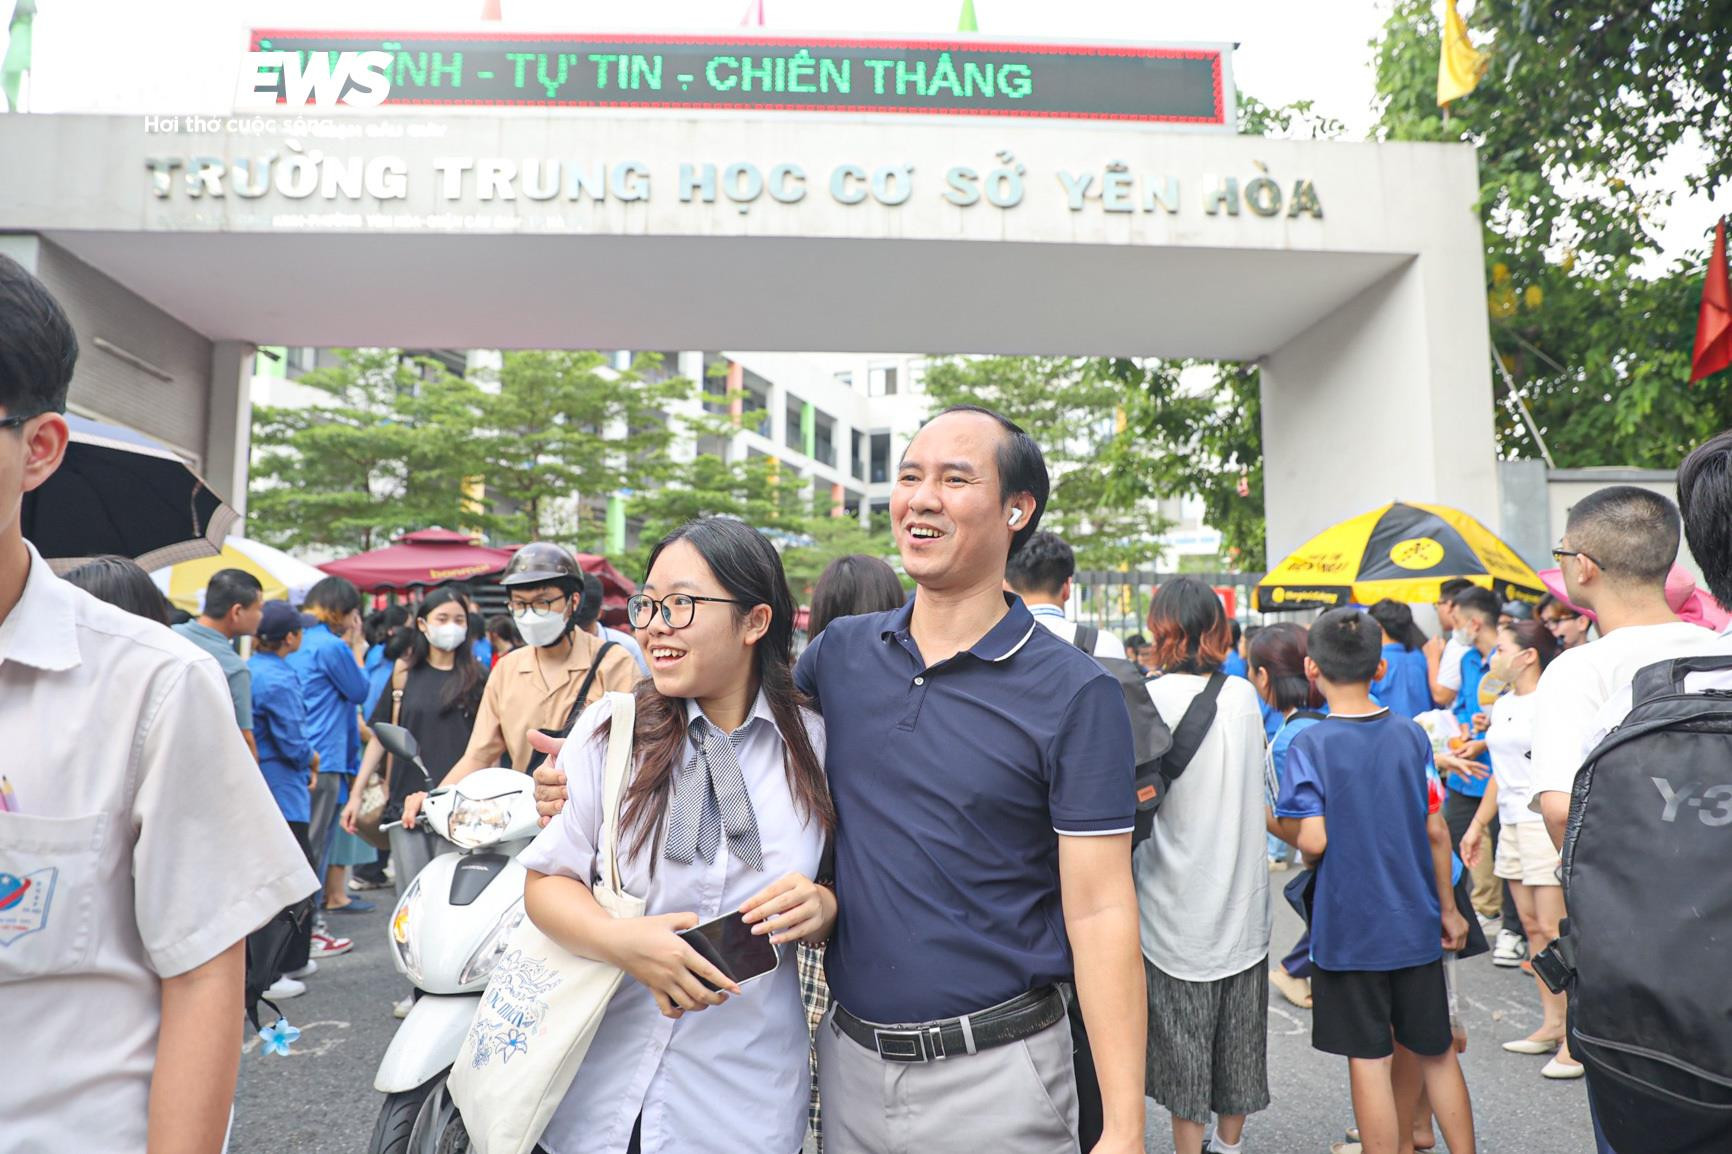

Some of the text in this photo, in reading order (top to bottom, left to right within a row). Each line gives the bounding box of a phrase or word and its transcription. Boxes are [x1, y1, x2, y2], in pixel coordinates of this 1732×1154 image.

[506, 53, 577, 98] TỰ
[588, 54, 663, 90] TIN
[145, 138, 1324, 219] TRƯỜNG TRUNG HỌC CƠ SỞ YÊN HÒA
[1650, 776, 1732, 827] Y-3
